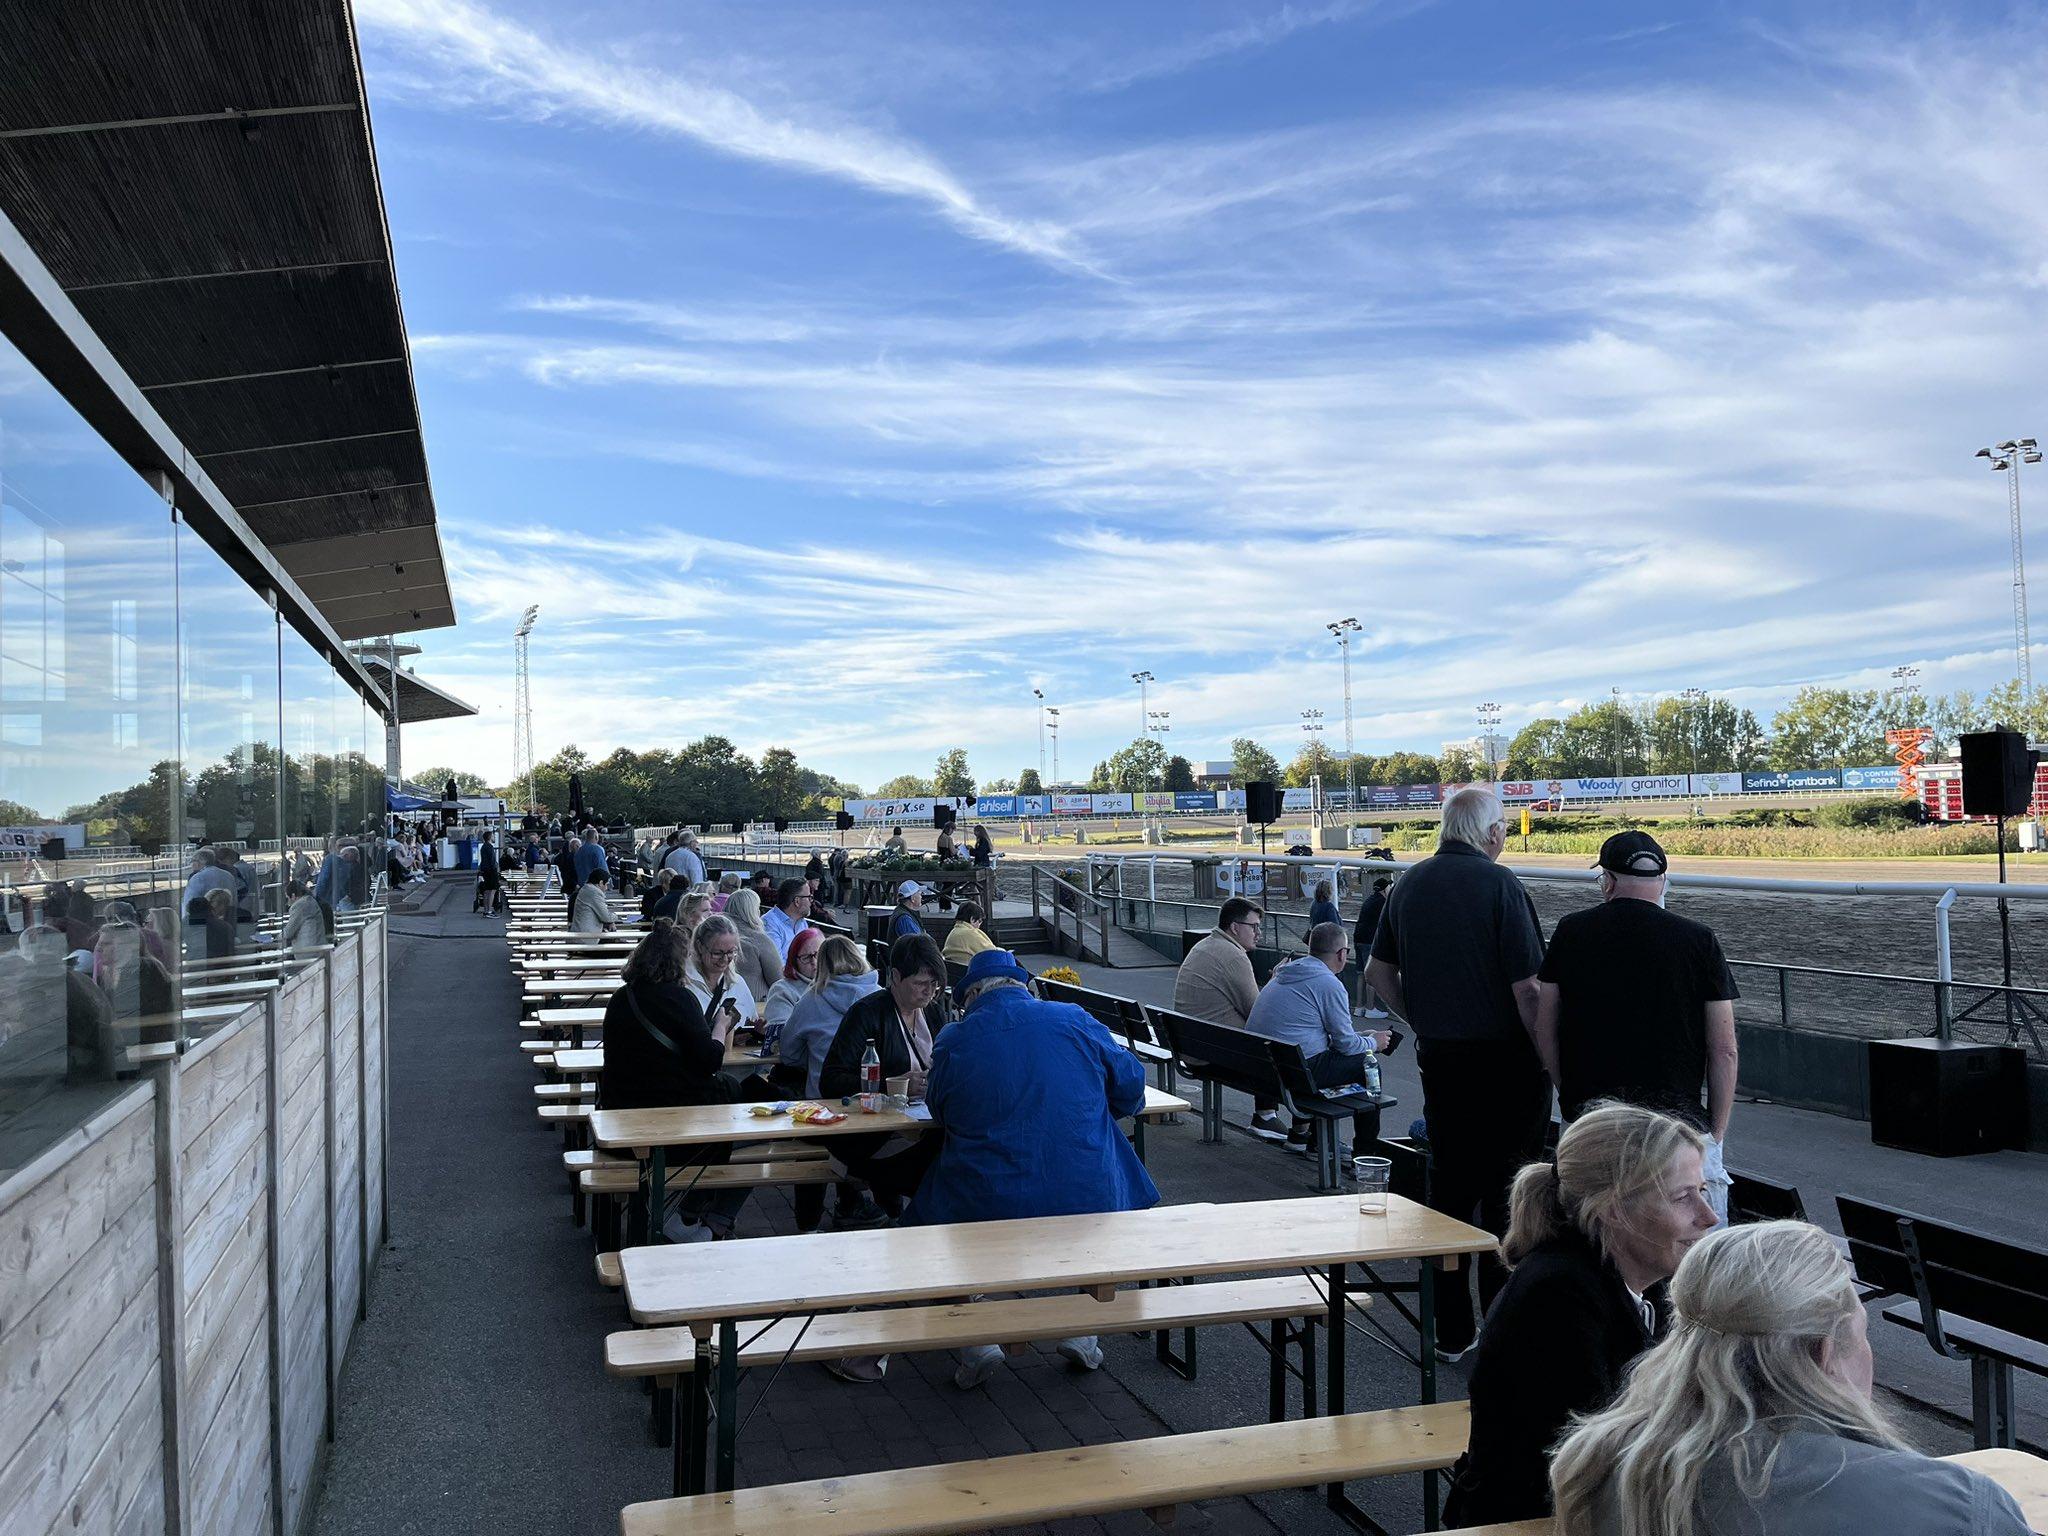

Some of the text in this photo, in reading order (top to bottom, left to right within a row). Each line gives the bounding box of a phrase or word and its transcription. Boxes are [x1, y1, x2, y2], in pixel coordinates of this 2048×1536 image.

[1577, 778, 1623, 796] Woody
[1631, 776, 1682, 792] granitor
[1746, 775, 1838, 788] Sefina pantbank
[1502, 783, 1534, 796] SVB
[979, 799, 1013, 812] ahlsell
